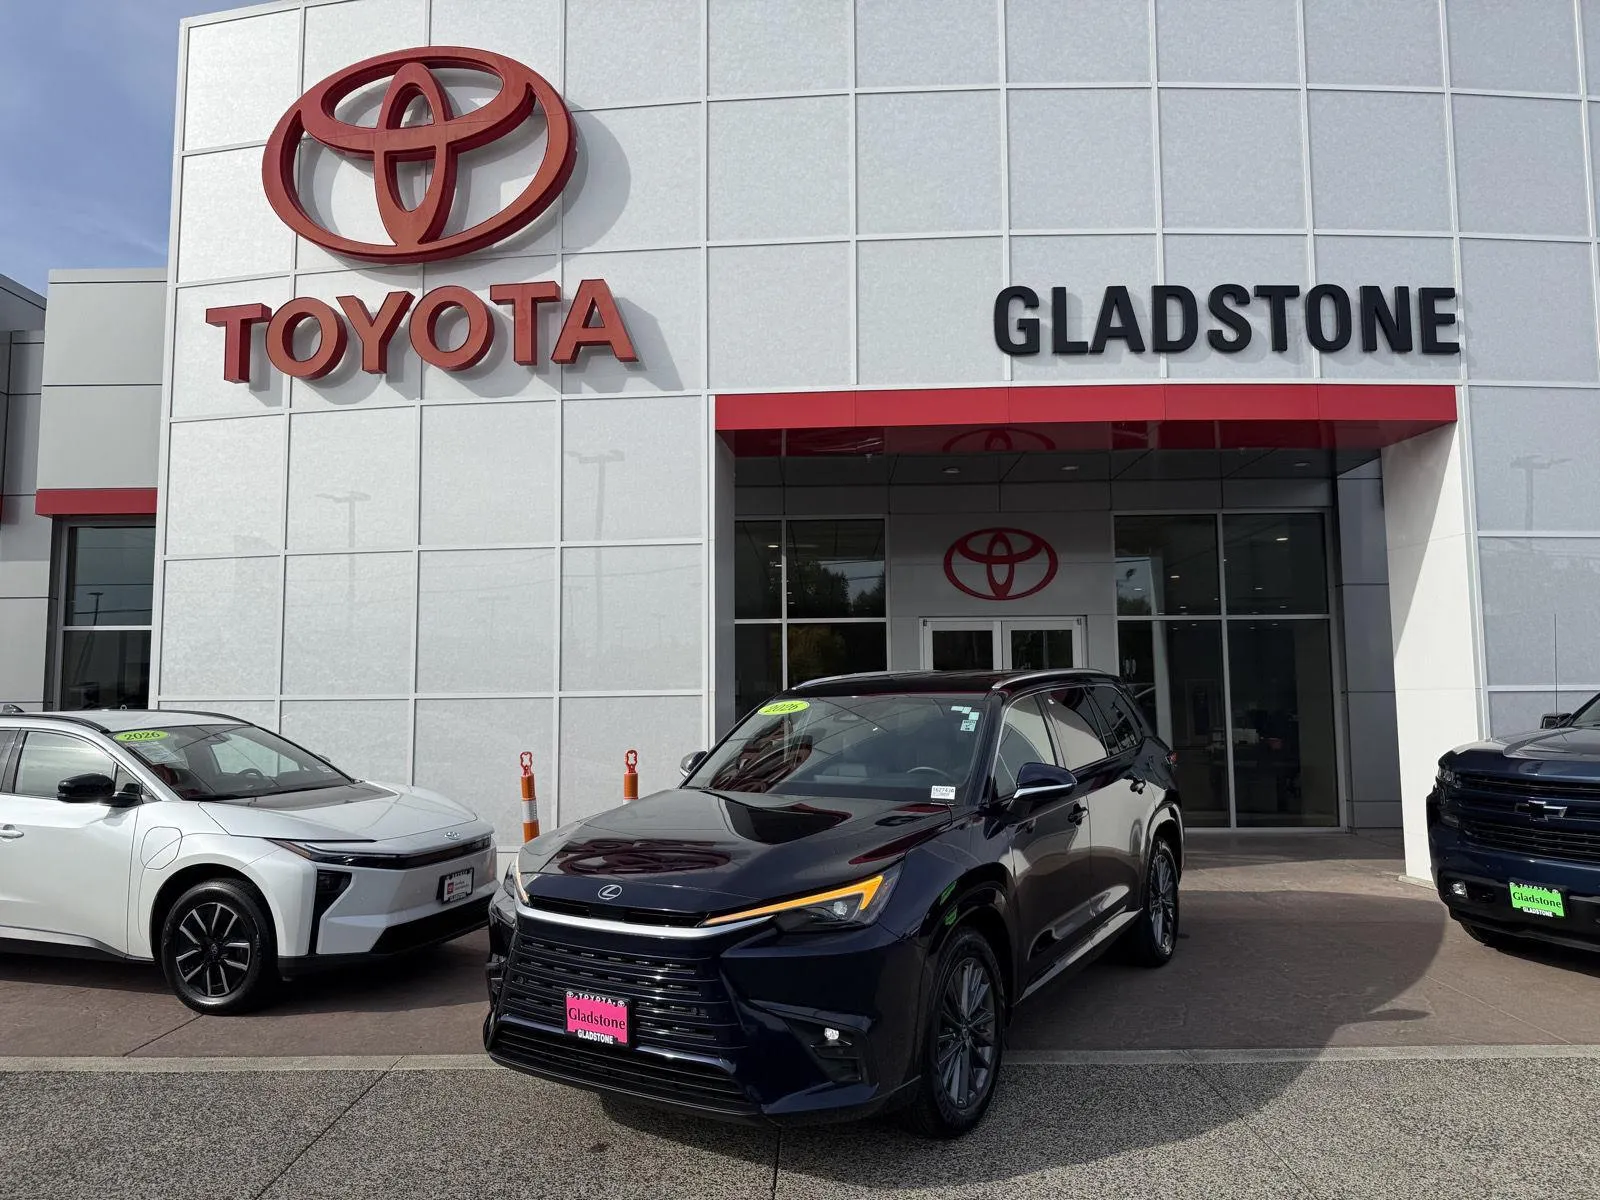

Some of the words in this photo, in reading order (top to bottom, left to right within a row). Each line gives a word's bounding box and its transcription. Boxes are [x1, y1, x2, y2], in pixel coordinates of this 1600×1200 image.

[994, 283, 1460, 355] GLADSTONE
[205, 279, 639, 384] TOYOTA
[124, 731, 160, 741] 2026
[1512, 891, 1562, 908] Gladstone
[1522, 906, 1554, 918] GLADSTONE
[578, 992, 613, 1006] TOYOTA
[568, 1007, 626, 1030] Gladstone
[577, 1029, 614, 1045] GLADSTONE
